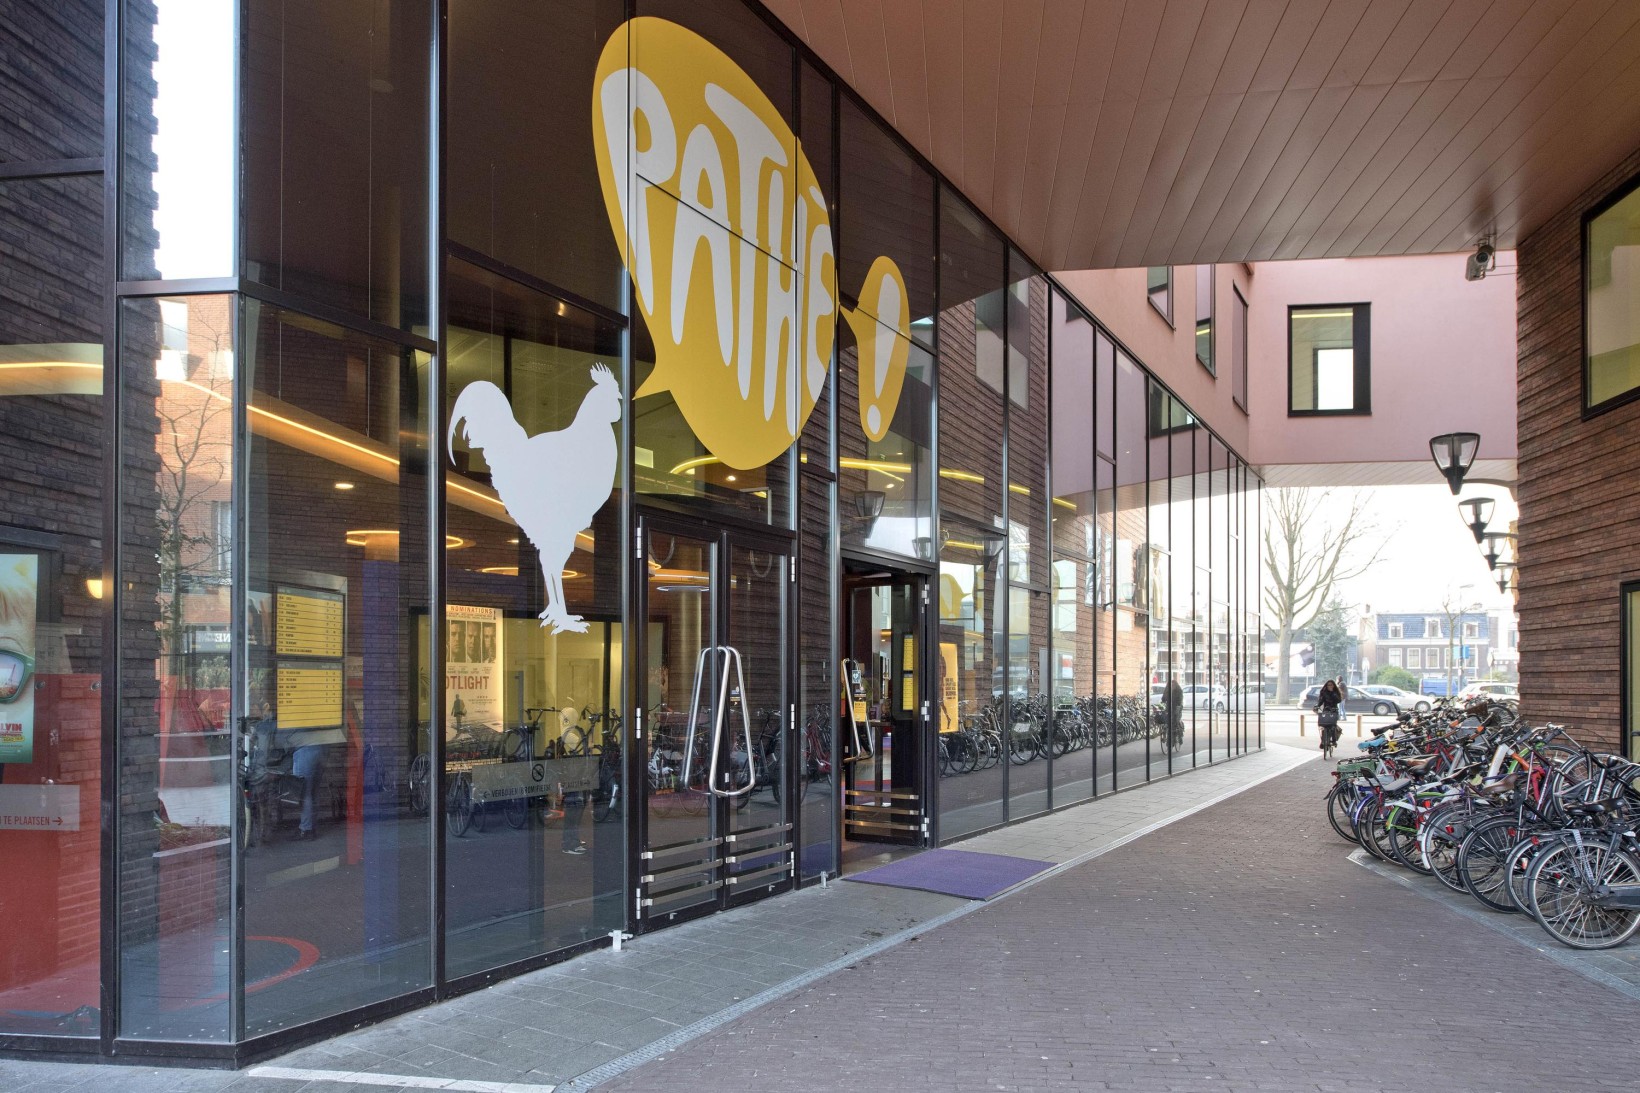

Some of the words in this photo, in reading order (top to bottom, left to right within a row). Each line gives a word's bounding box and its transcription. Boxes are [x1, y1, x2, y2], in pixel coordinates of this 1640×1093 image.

[450, 605, 493, 615] NOMINATIONS
[3, 815, 12, 825] TE
[14, 815, 50, 826] PLAATSEN
